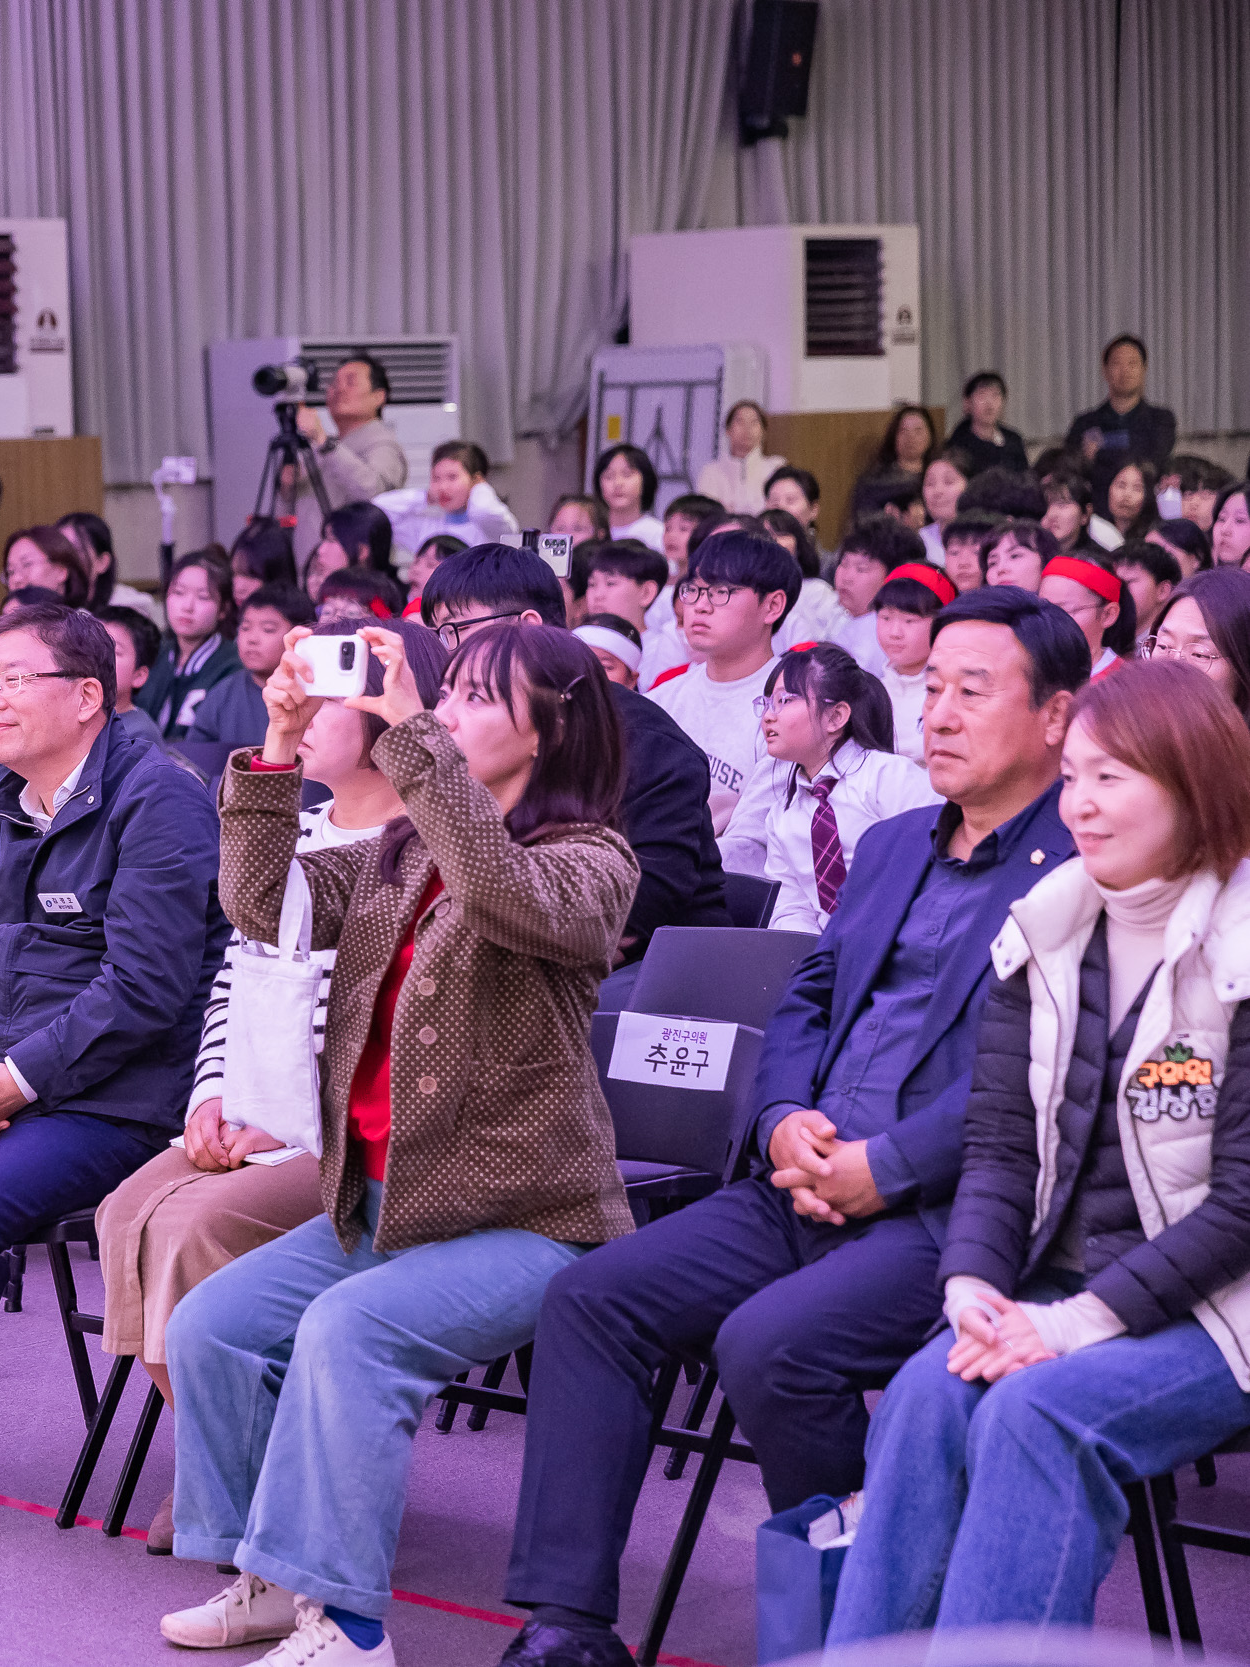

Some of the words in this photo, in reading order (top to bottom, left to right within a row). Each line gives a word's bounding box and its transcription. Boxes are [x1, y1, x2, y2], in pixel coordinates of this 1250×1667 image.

[707, 754, 743, 794] USE
[661, 1027, 708, 1045] 광진구의원
[644, 1043, 709, 1078] 추윤구
[1137, 1058, 1212, 1089] 구의원
